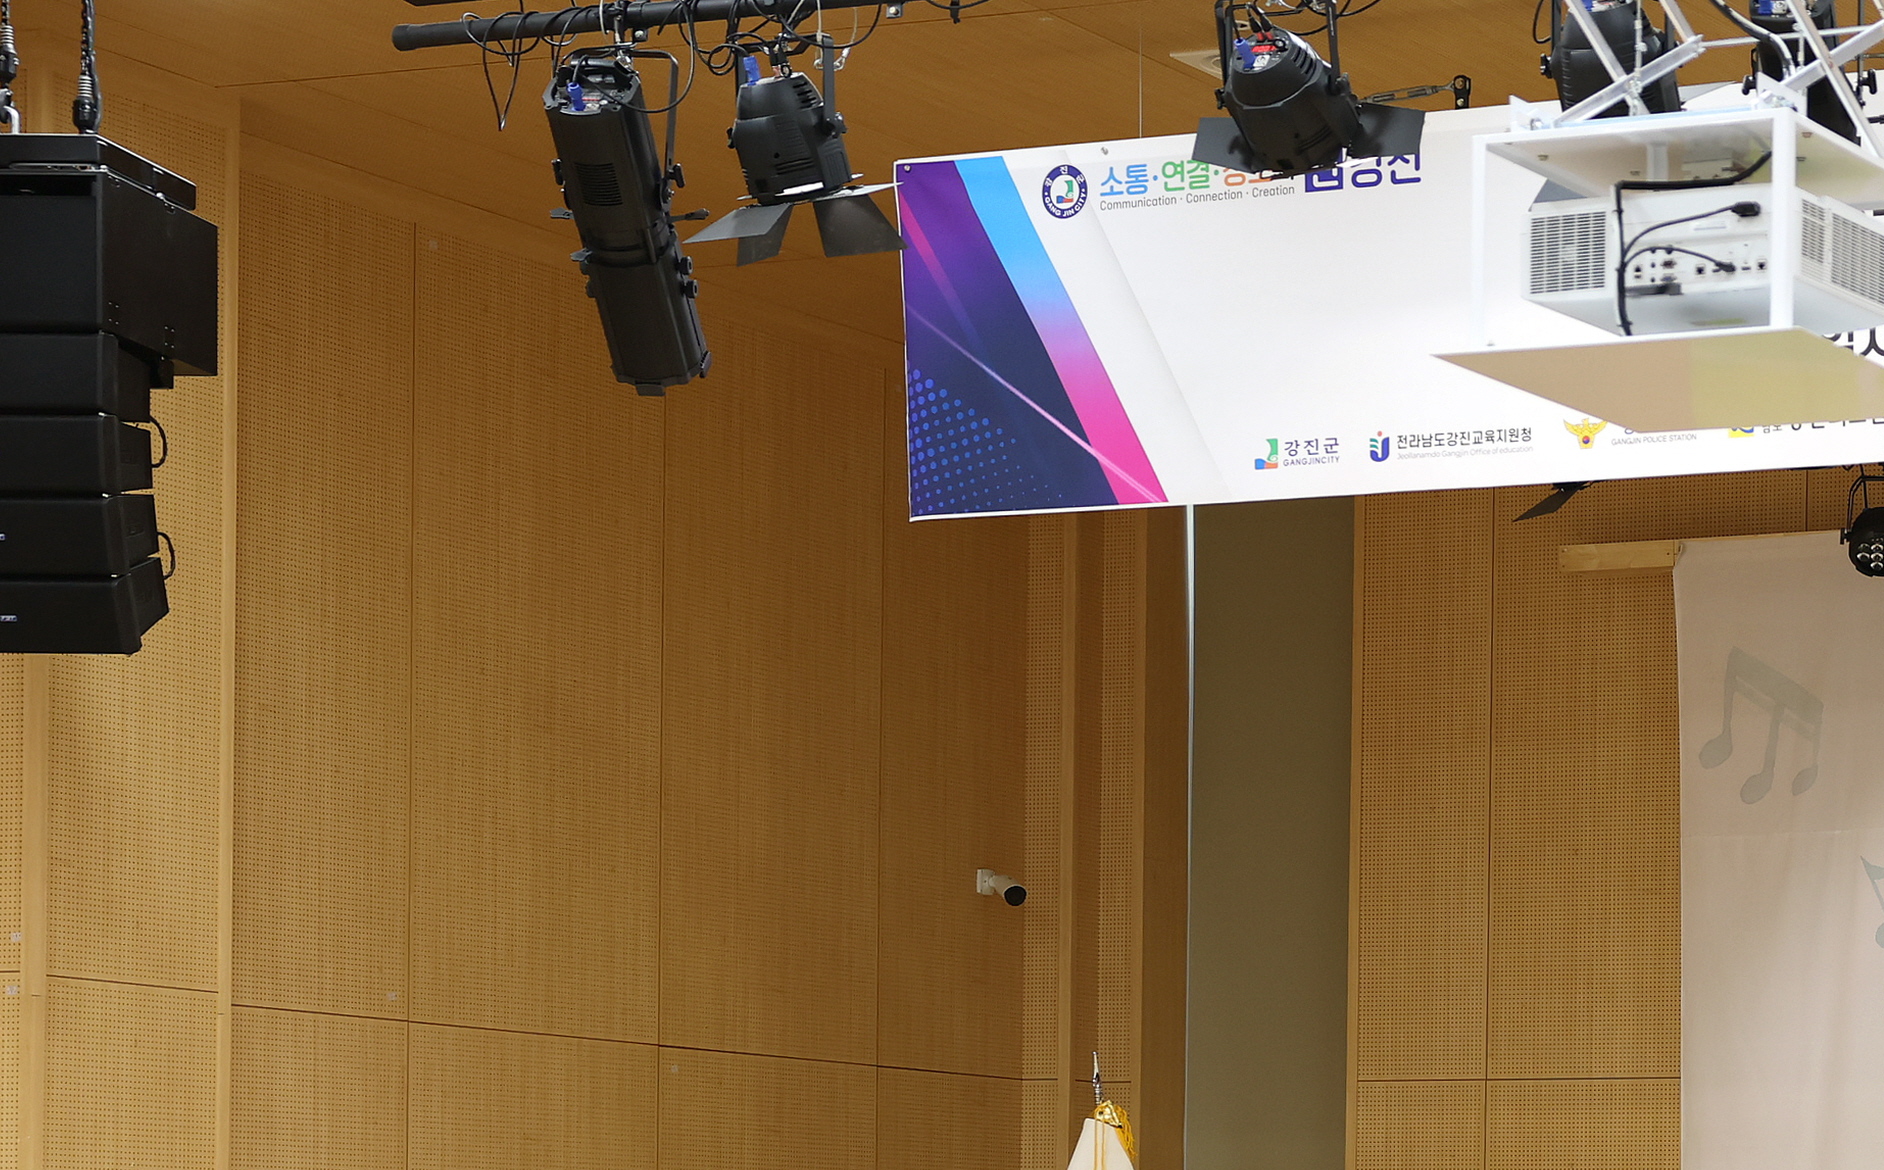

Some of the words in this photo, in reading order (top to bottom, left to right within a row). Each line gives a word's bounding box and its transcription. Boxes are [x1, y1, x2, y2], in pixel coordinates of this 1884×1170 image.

[1045, 196, 1062, 217] GANG
[1074, 193, 1086, 213] CITY
[1100, 195, 1177, 211] Communication
[1186, 188, 1243, 204] Connection
[1252, 184, 1295, 198] Creation
[1284, 437, 1340, 456] 강진군
[1397, 427, 1532, 449] 전라남도강진교육지원청
[1643, 435, 1667, 444] POLICE
[1669, 433, 1697, 442] STATION
[1283, 455, 1340, 467] GANGJINCITY
